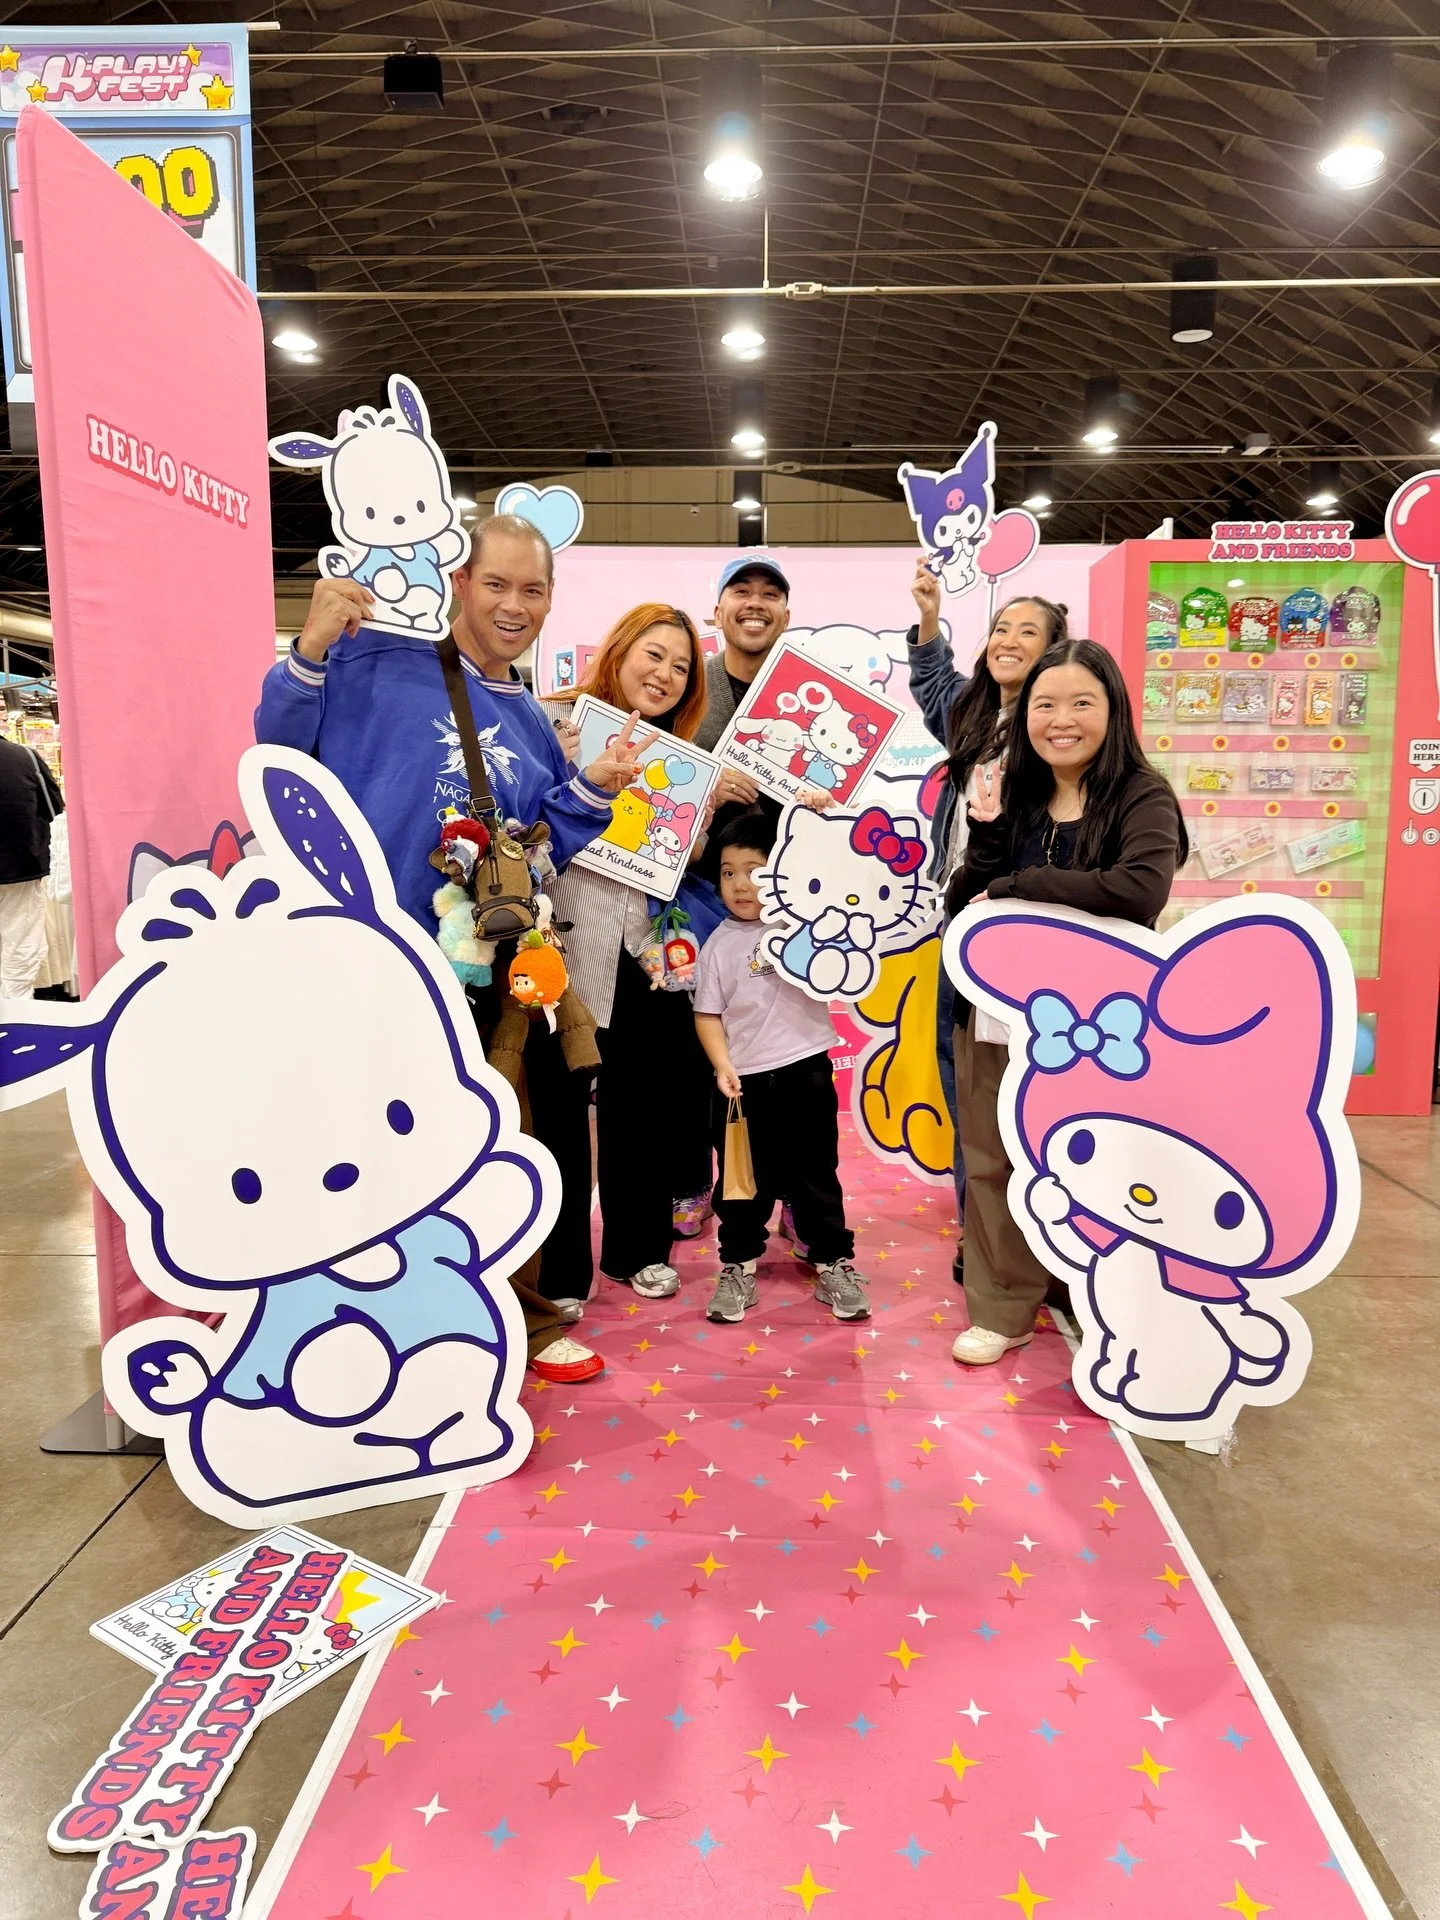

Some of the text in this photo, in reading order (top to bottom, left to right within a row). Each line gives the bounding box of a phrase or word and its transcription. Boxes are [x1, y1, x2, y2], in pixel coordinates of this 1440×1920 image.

[98, 75, 188, 101] FEST
[86, 414, 249, 529] HELLO KITTY
[1211, 542, 1352, 559] AND FRIENDS
[1215, 523, 1350, 539] HELLO KITTY
[725, 745, 799, 794] Hello Kitty And
[1413, 743, 1440, 751] COIN
[434, 780, 471, 803] NAGA
[583, 845, 656, 879] ead Kindness
[114, 1614, 178, 1660] Hello Kitty
[57, 1546, 294, 1841] AND FRIENDS
[134, 1551, 348, 1837] HELLO KITTY
[89, 1840, 170, 1920] AN
[164, 1833, 248, 1920] HE
